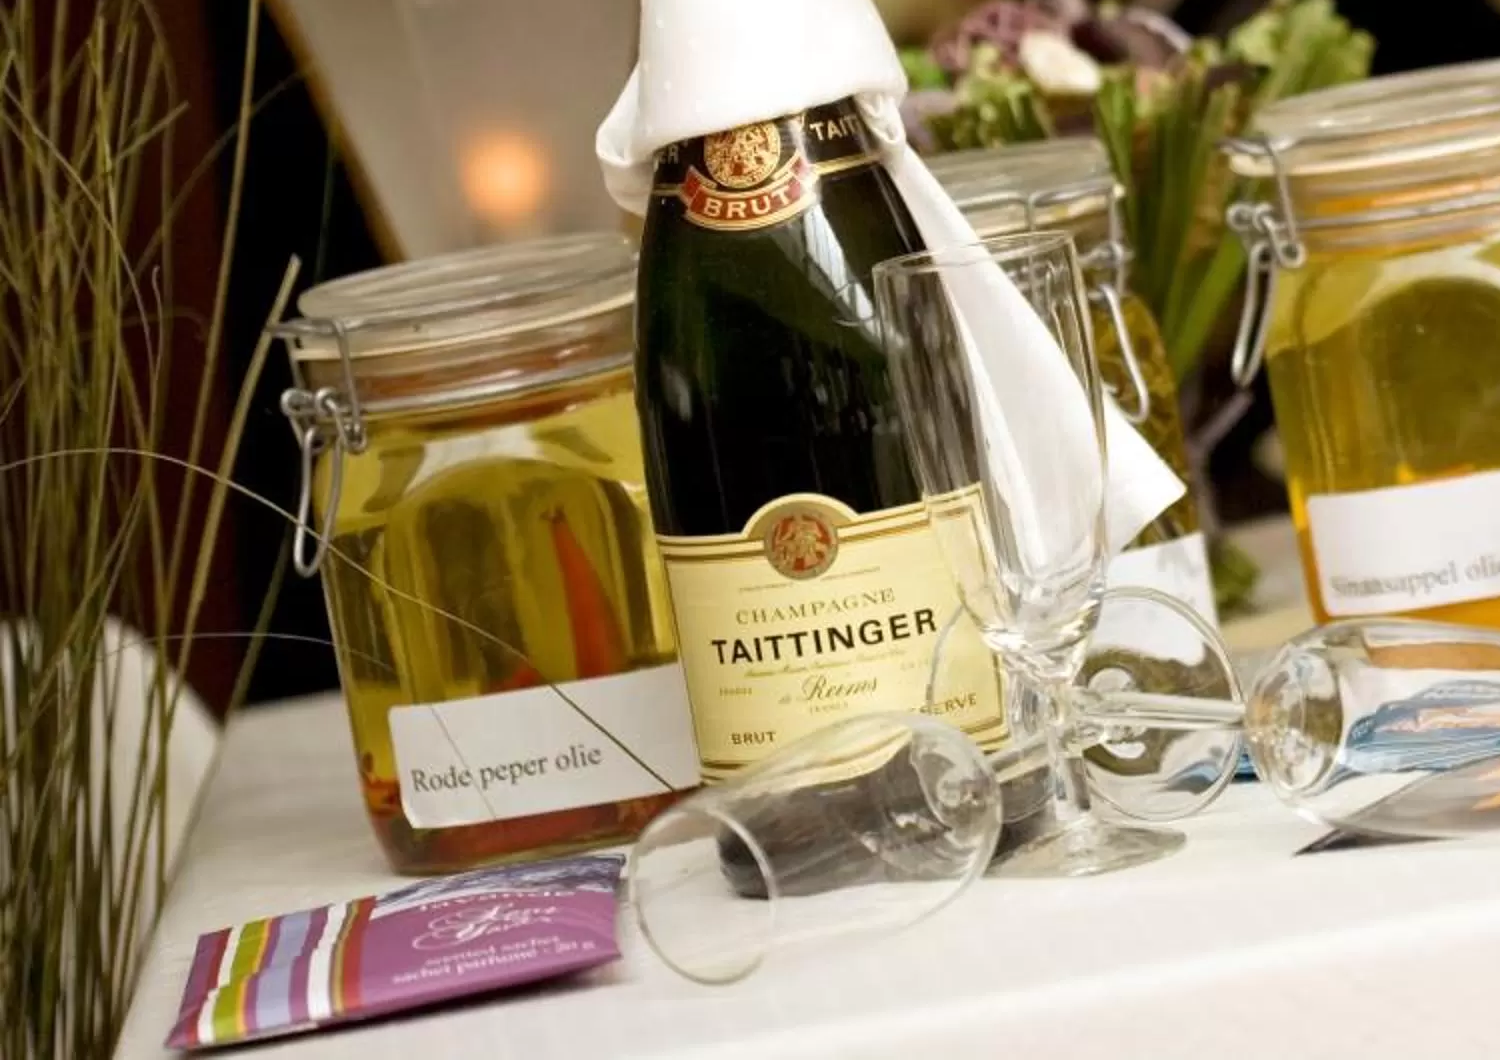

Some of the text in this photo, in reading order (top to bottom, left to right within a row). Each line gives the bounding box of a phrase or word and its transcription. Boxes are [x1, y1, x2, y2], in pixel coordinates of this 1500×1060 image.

[703, 190, 791, 219] BRUT
[736, 587, 896, 626] CHAMPAGNE
[711, 607, 937, 665] TAITTINGER
[731, 730, 777, 746] BRUT
[411, 744, 602, 792] Rode peper olie
